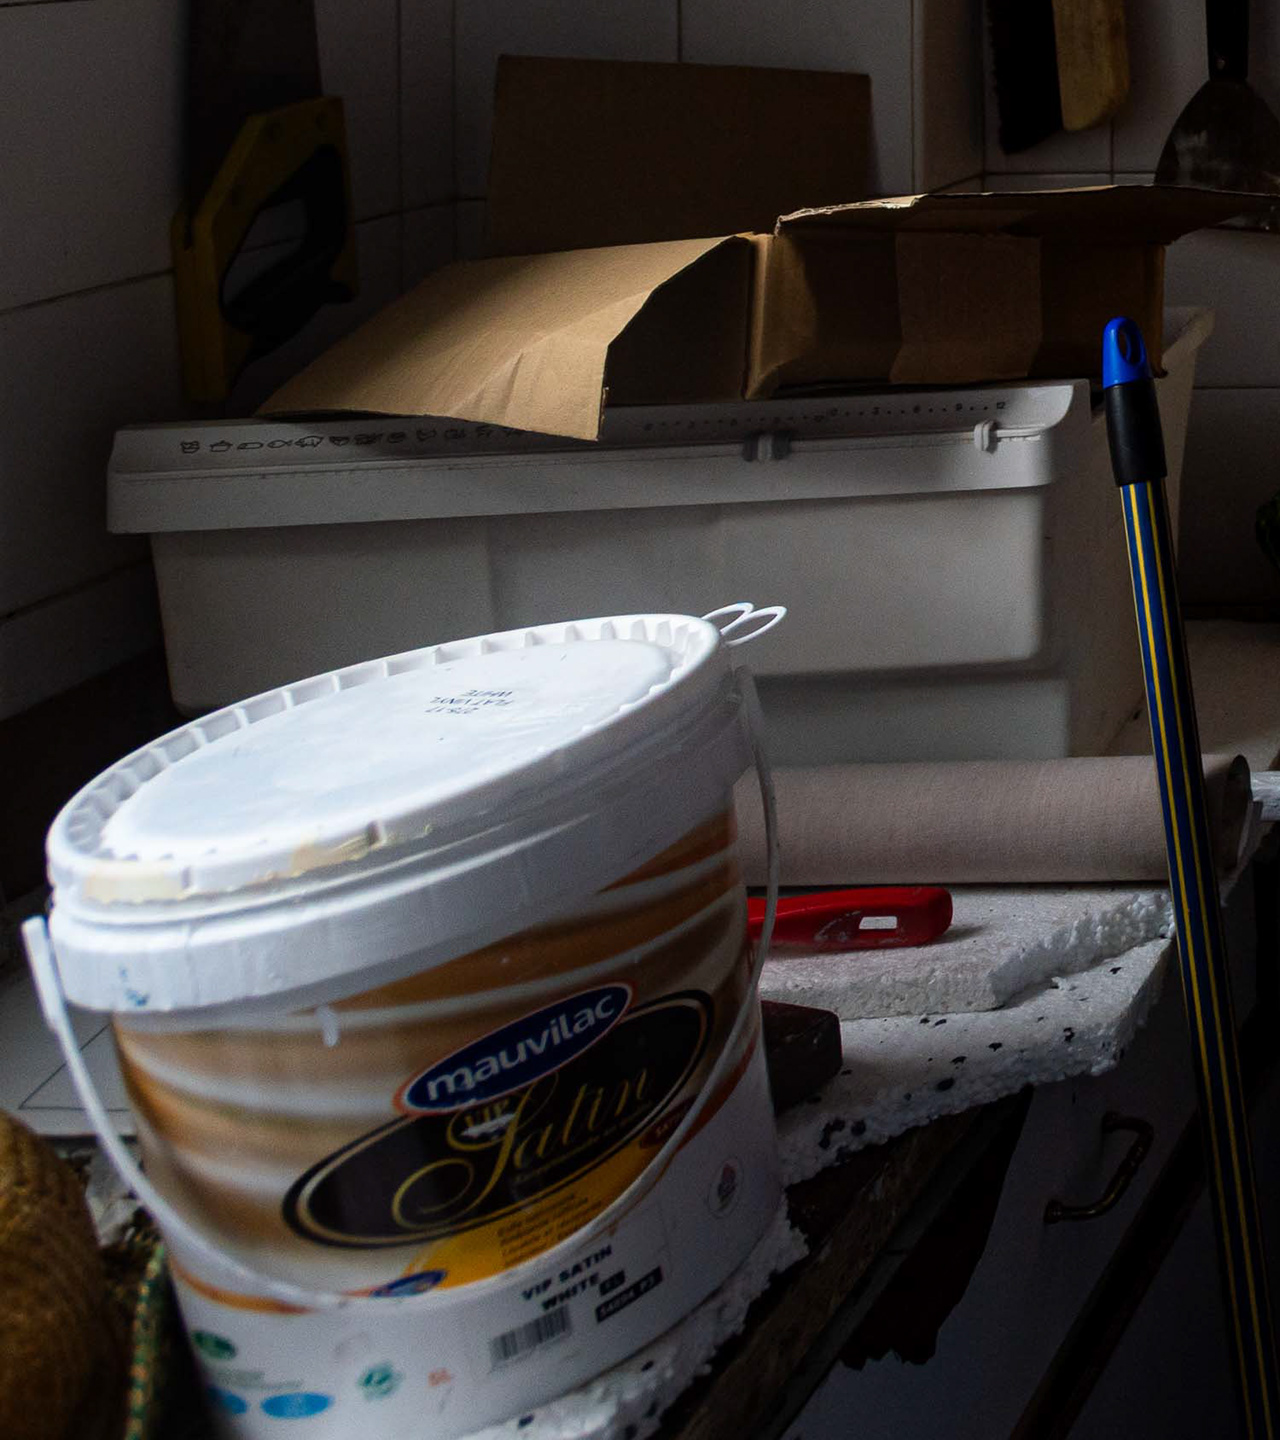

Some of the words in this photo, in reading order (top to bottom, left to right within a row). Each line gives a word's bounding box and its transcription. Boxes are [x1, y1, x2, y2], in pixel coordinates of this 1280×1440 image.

[425, 994, 615, 1101] mauvilac
[391, 1067, 648, 1230] Satin
[522, 1279, 552, 1301] VIP
[560, 1245, 613, 1283] SATIN
[541, 1272, 600, 1310] WHITE
